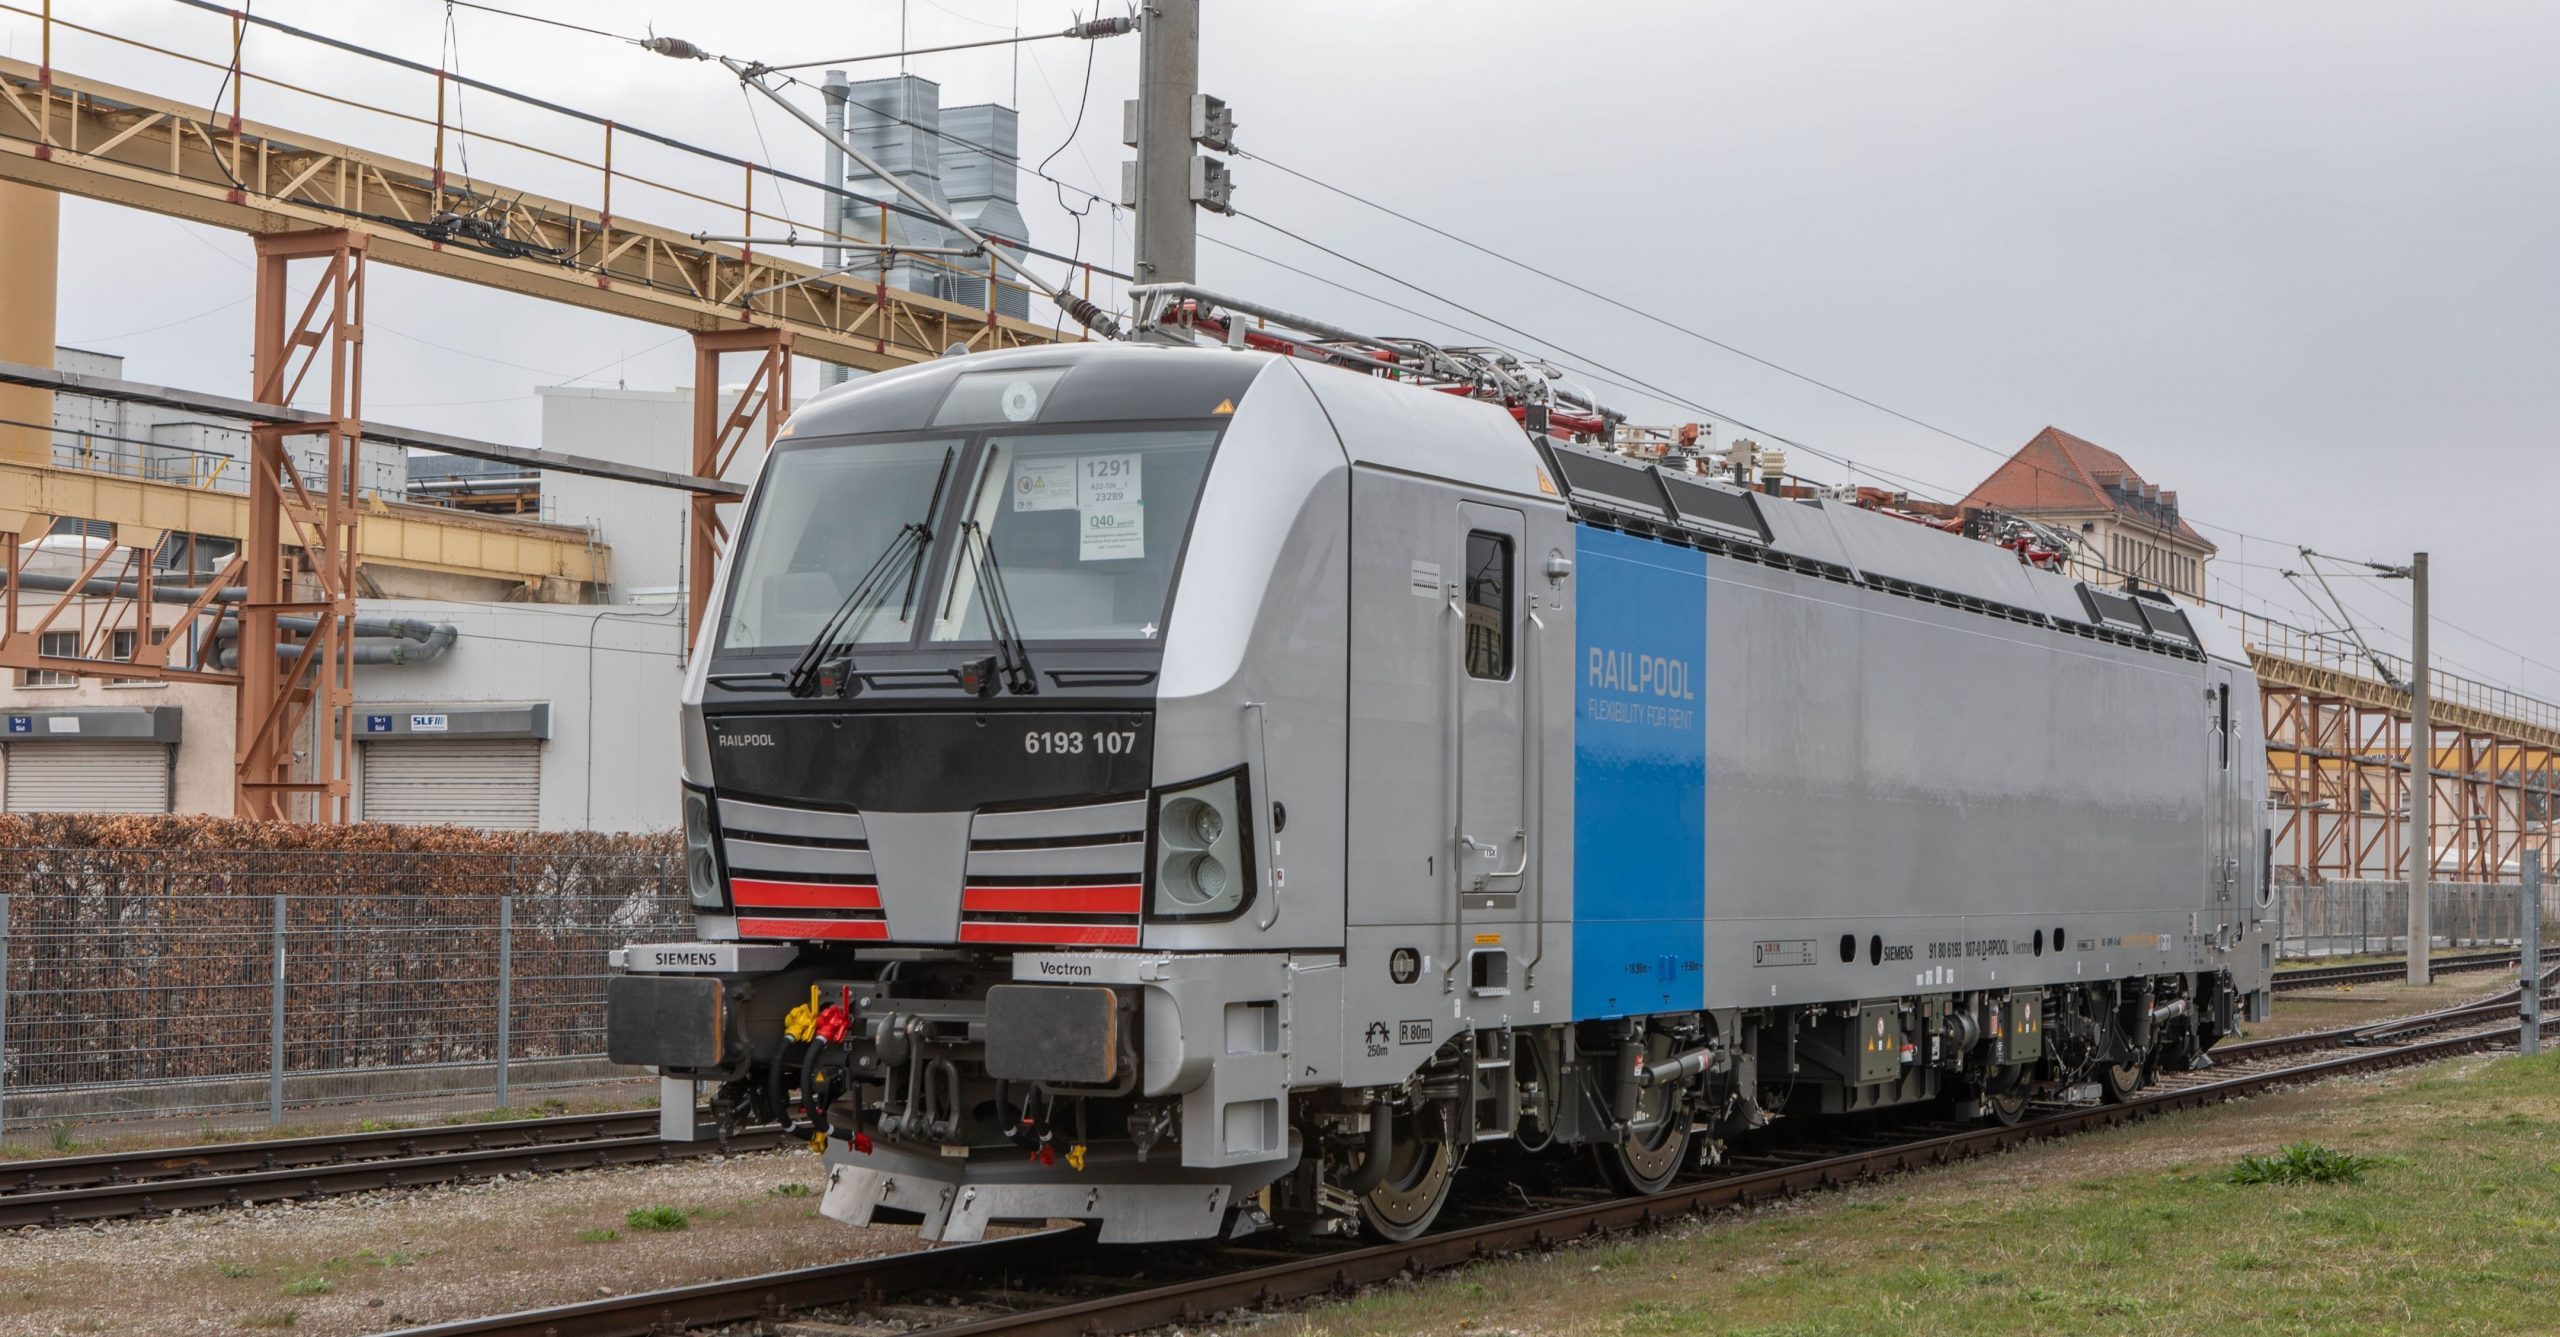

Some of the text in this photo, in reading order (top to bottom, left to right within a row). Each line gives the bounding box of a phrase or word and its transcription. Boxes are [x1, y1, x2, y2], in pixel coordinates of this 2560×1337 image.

[1087, 460, 1131, 478] 1291
[1095, 491, 1124, 502] 23289
[1090, 515, 1114, 529] Q40
[1589, 646, 1694, 700] RAILPOOL
[413, 716, 435, 726] SLF
[1588, 698, 1694, 730] FLEXIBILITY FOR RENT
[719, 734, 775, 747] RAILPOOL
[1025, 731, 1136, 754] 6193 107
[1427, 856, 1433, 876] 1
[1756, 945, 1763, 964] D
[1884, 945, 1914, 961] SIEMENS
[1929, 939, 2009, 959] 91 80 6193 107-0 D-RPOOL
[655, 952, 717, 966] SIEMENS
[1040, 961, 1092, 976] Vectron
[1401, 1024, 1431, 1041] R 80m
[1367, 1044, 1389, 1058] 250m
